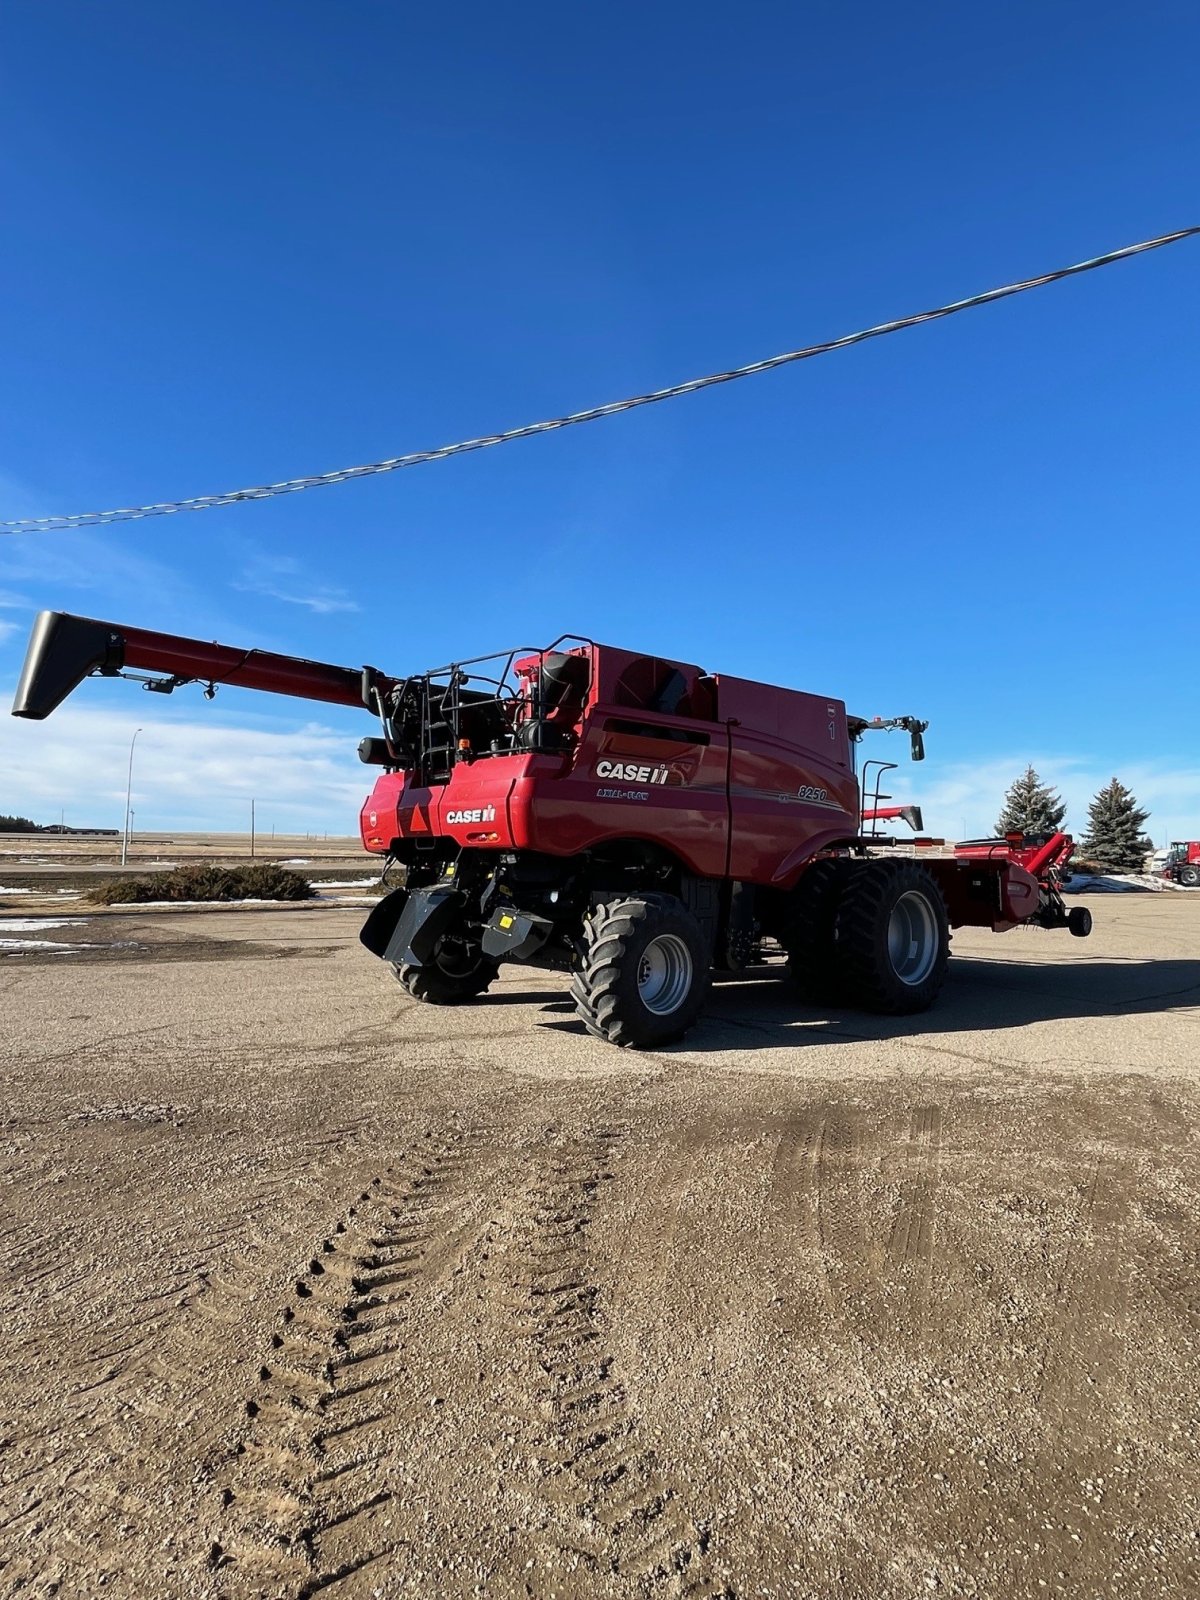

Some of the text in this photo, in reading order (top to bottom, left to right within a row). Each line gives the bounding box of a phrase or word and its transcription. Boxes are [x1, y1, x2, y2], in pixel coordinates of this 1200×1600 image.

[596, 760, 651, 782] CASE
[798, 785, 828, 801] 8250
[446, 809, 482, 824] CASE
